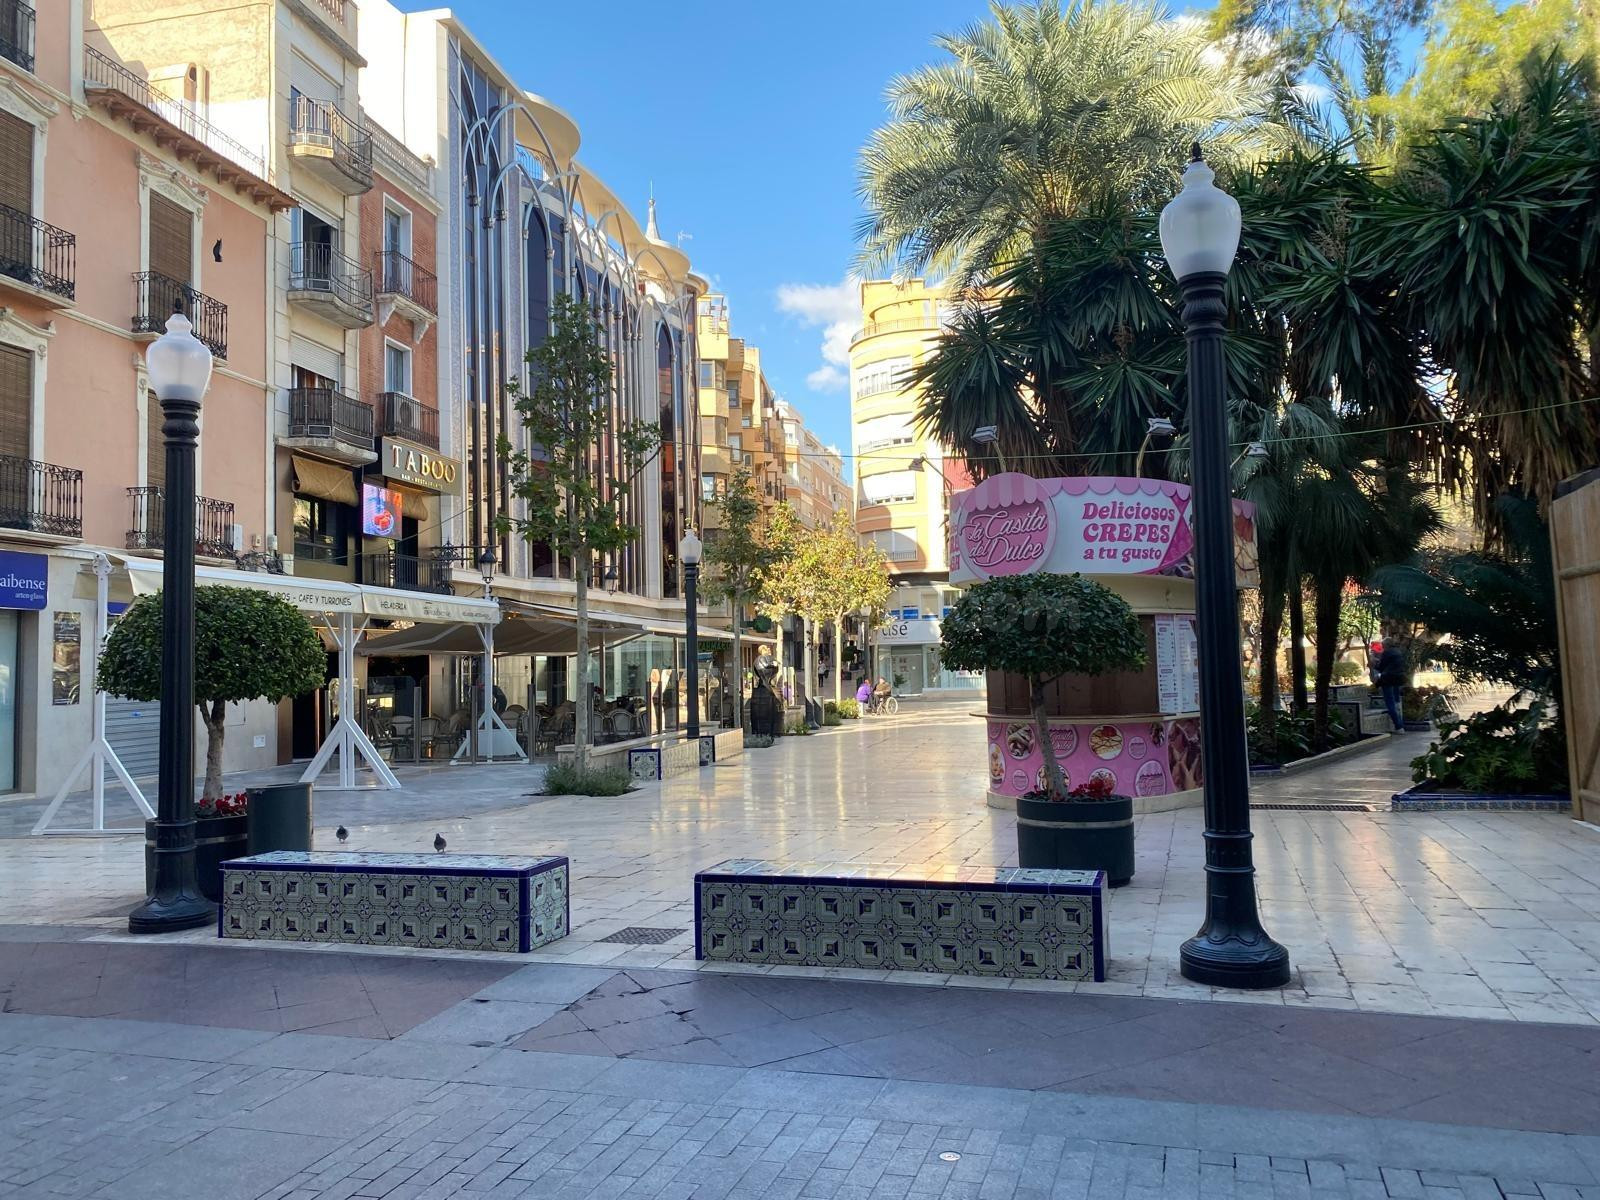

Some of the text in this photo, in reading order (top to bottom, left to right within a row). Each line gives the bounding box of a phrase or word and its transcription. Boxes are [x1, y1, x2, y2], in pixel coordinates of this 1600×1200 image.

[392, 445, 456, 483] TABOO
[1082, 500, 1175, 521] Deliciosos
[972, 507, 1047, 539] Casita
[1083, 523, 1170, 543] CREPES
[969, 540, 989, 558] del
[973, 535, 1044, 567] Dulce
[1083, 547, 1162, 563] a tu gusto
[321, 596, 352, 607] TURRONES
